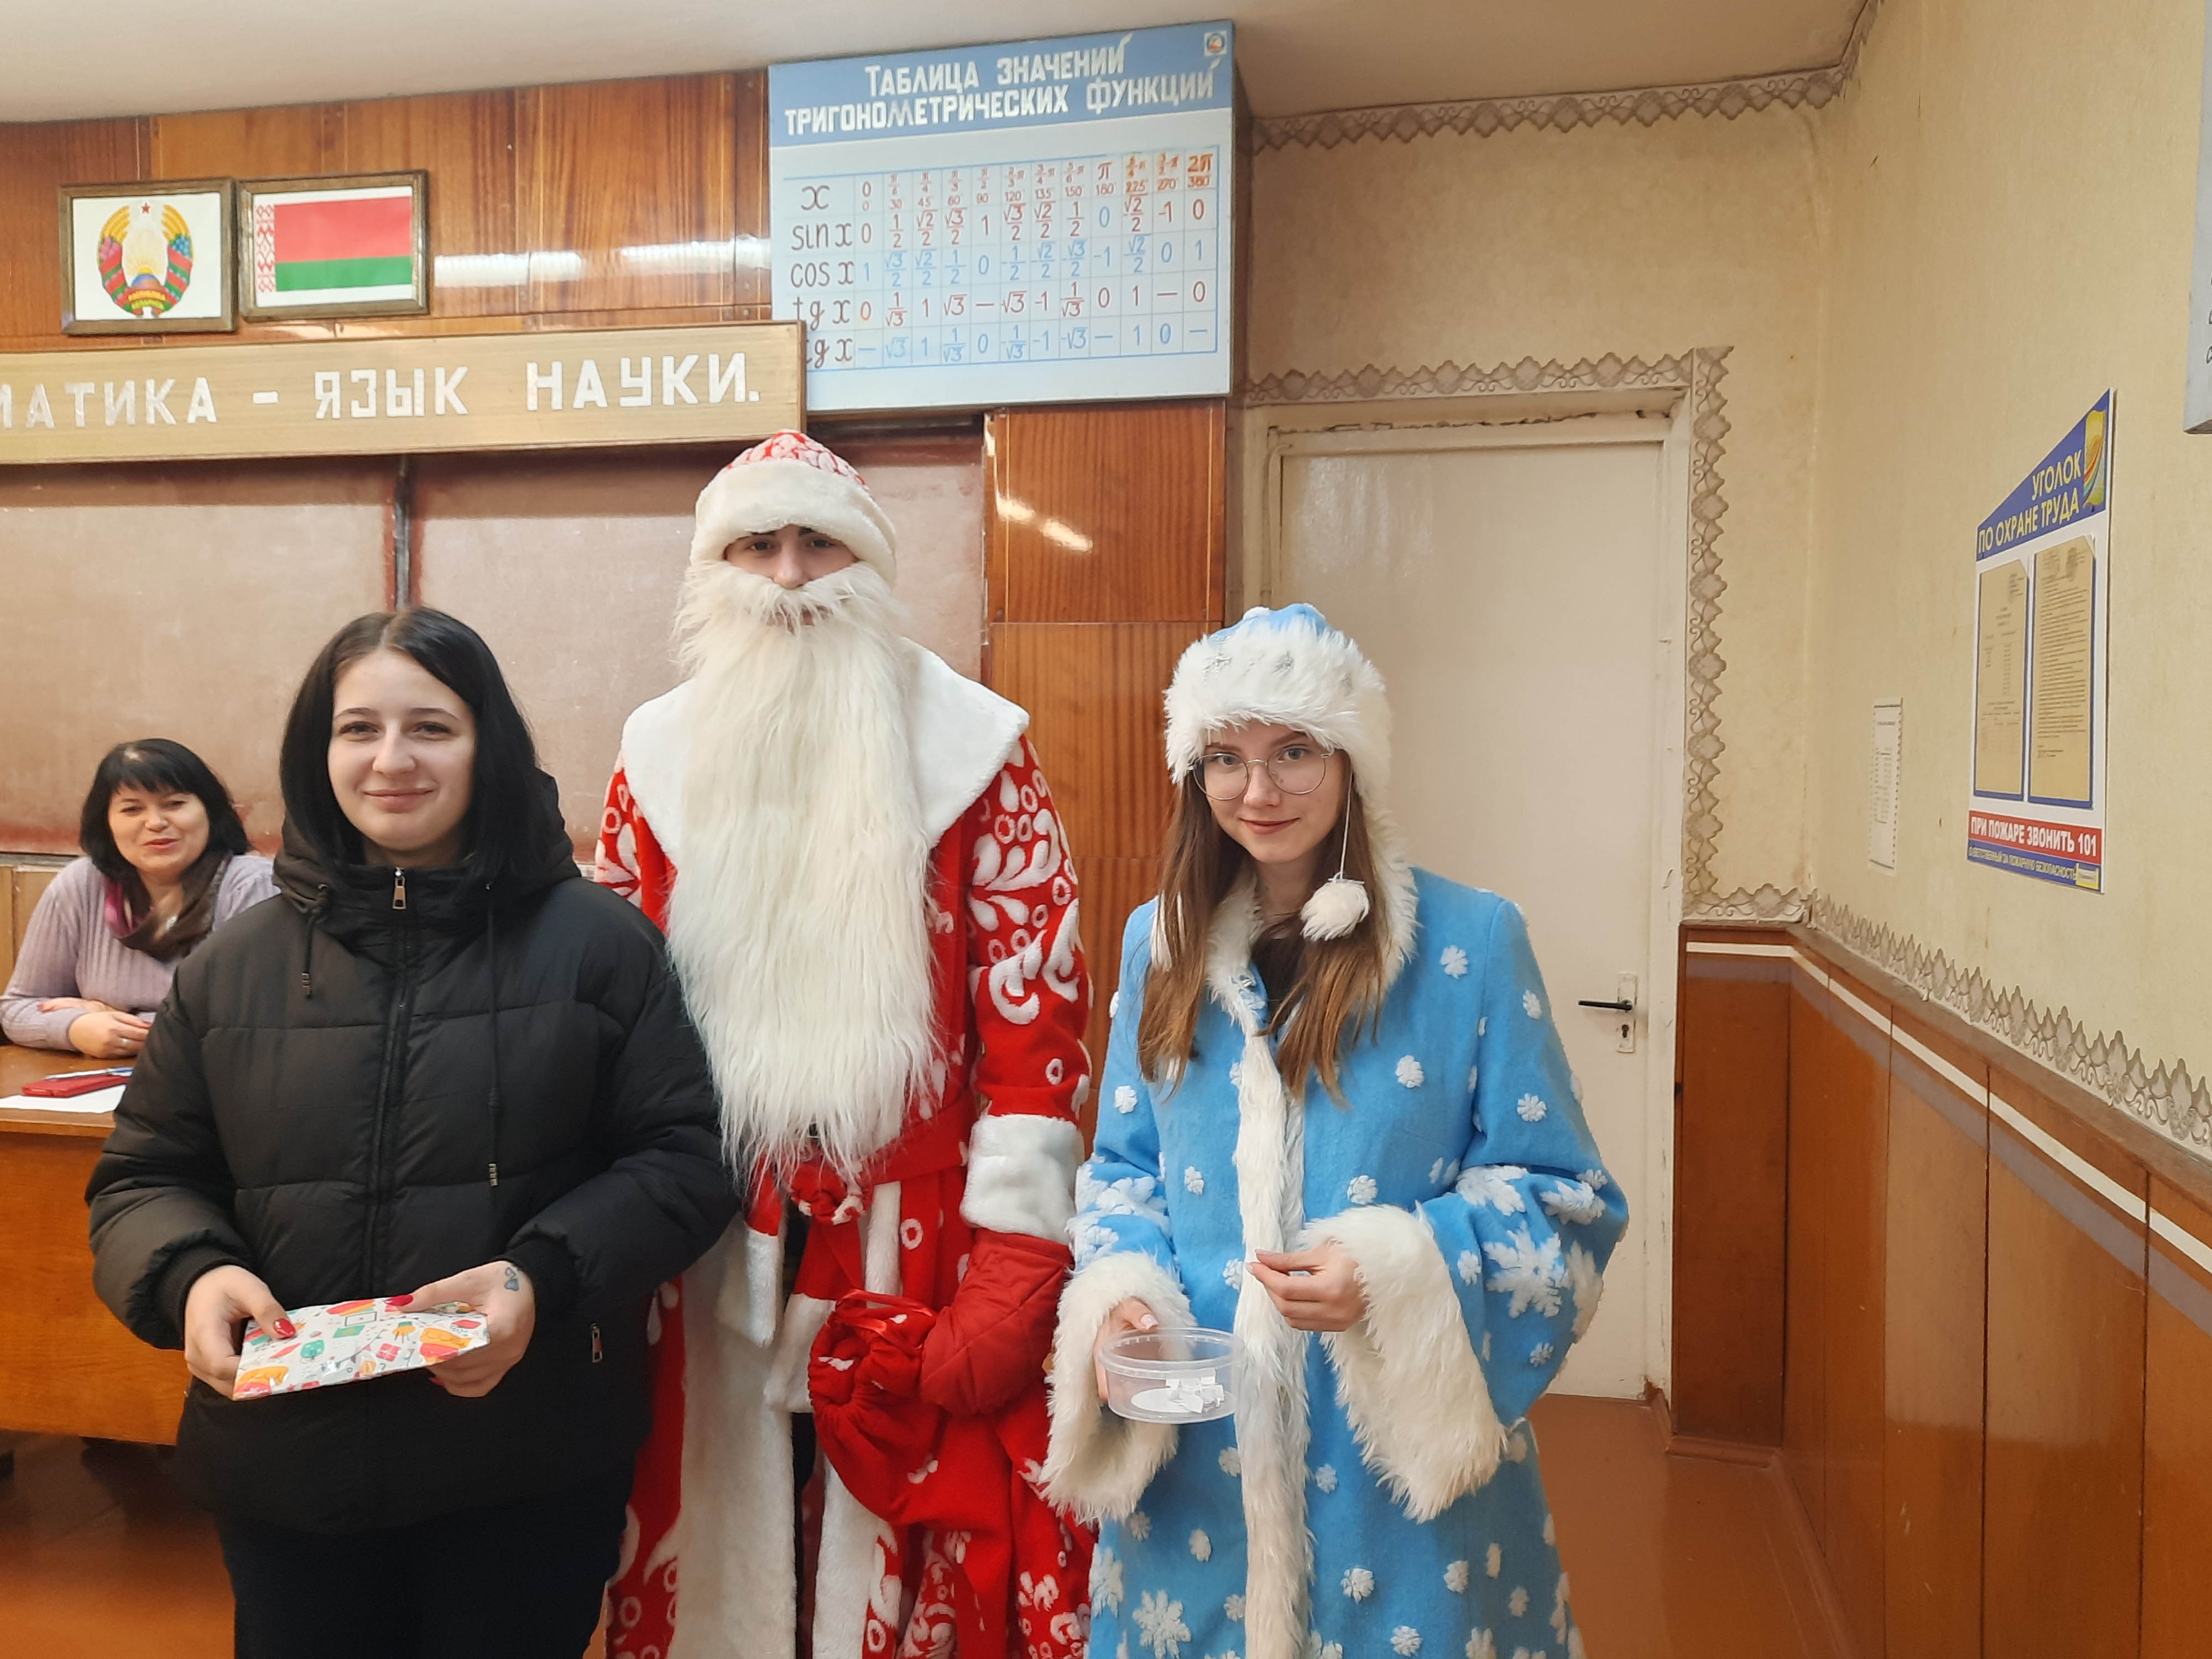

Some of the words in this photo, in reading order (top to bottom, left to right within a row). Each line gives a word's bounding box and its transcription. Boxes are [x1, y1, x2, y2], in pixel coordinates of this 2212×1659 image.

[785, 85, 1070, 137] ТРИГОНОМЕТРИЧЕСКИХ
[1087, 58, 1223, 114] ФУНКЦИЙ
[865, 61, 980, 97] ТАБЛИЦА
[996, 32, 1134, 85] ЗНАЧЕНИЙ
[315, 366, 469, 420] ЯЗЫК
[526, 352, 761, 411] НАУКИ.
[2031, 449, 2083, 501] УГОЛОК
[1978, 526, 1992, 554] ПО
[1995, 505, 2038, 547] ОХРАНЕ
[2041, 487, 2079, 528] ТРУДА
[1971, 816, 1986, 837] ПРИ
[1989, 820, 2025, 844] ПОЖАРЕ
[2027, 826, 2075, 853] ЗВОНИТЬ
[2078, 833, 2097, 857] 101
